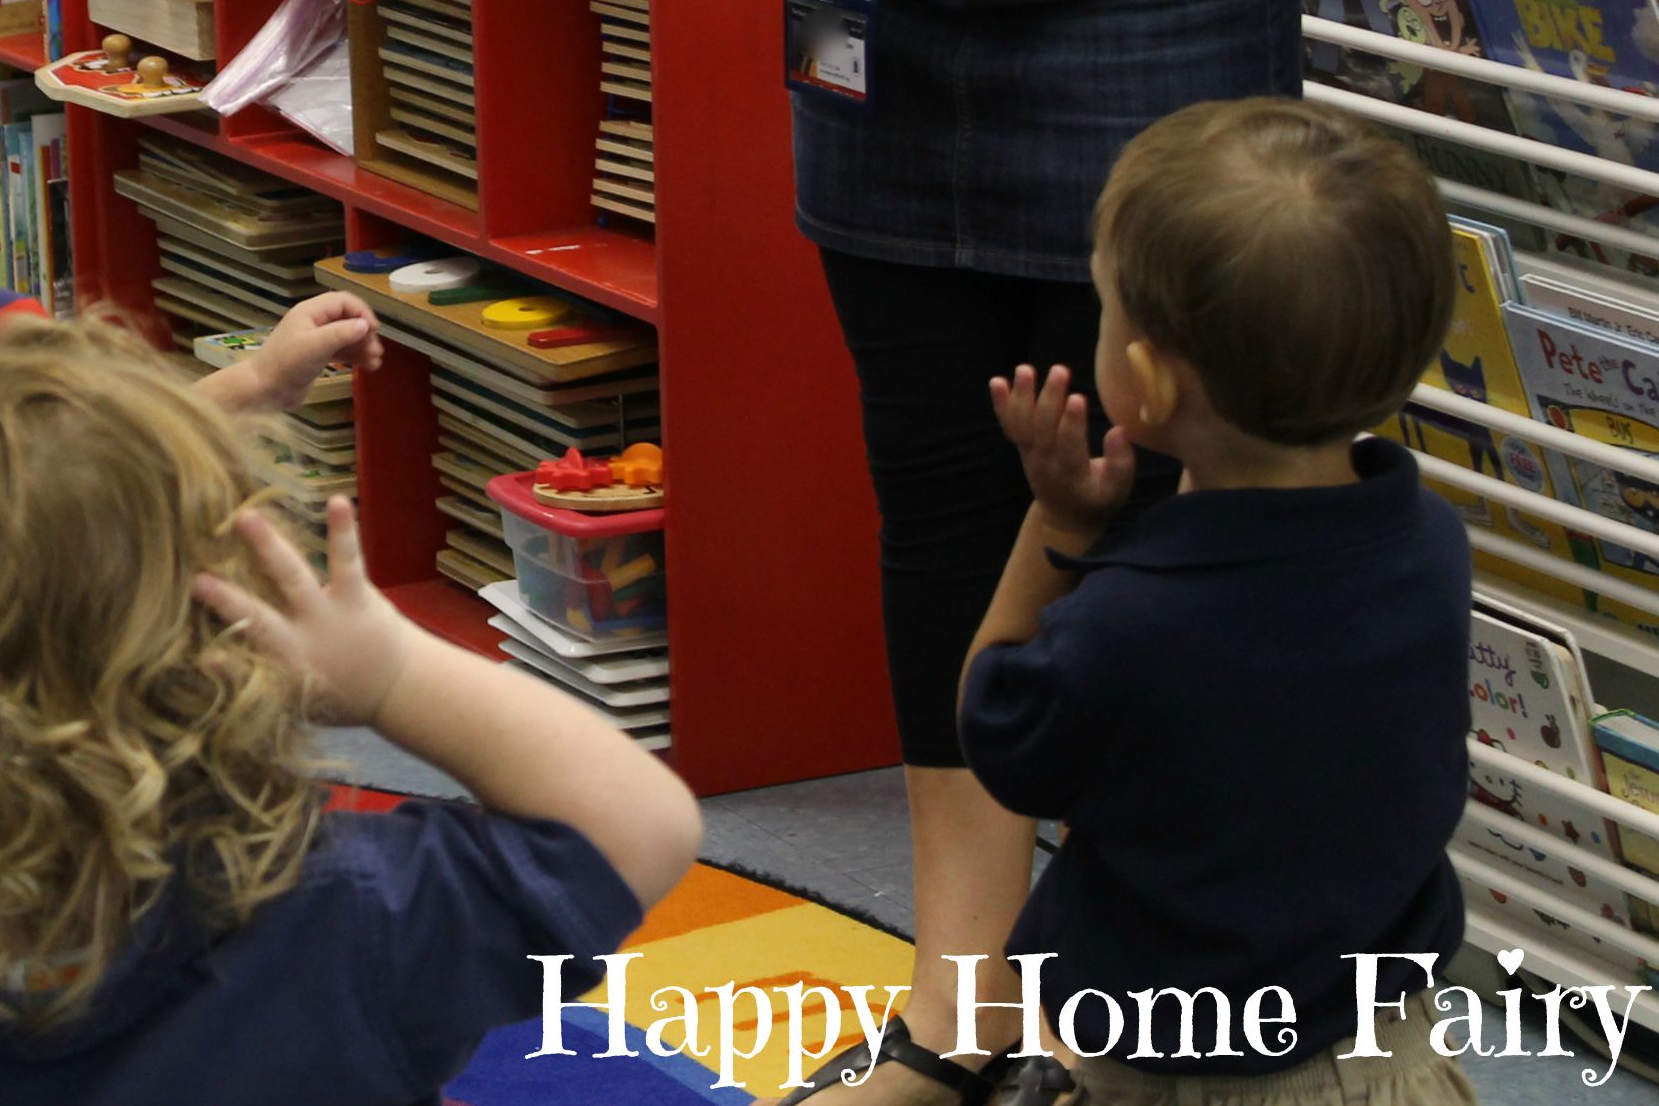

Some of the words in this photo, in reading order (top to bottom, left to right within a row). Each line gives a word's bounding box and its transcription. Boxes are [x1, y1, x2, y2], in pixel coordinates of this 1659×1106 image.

[1537, 327, 1604, 384] Pete
[1621, 359, 1659, 402] Ca
[1468, 679, 1529, 719] olor!
